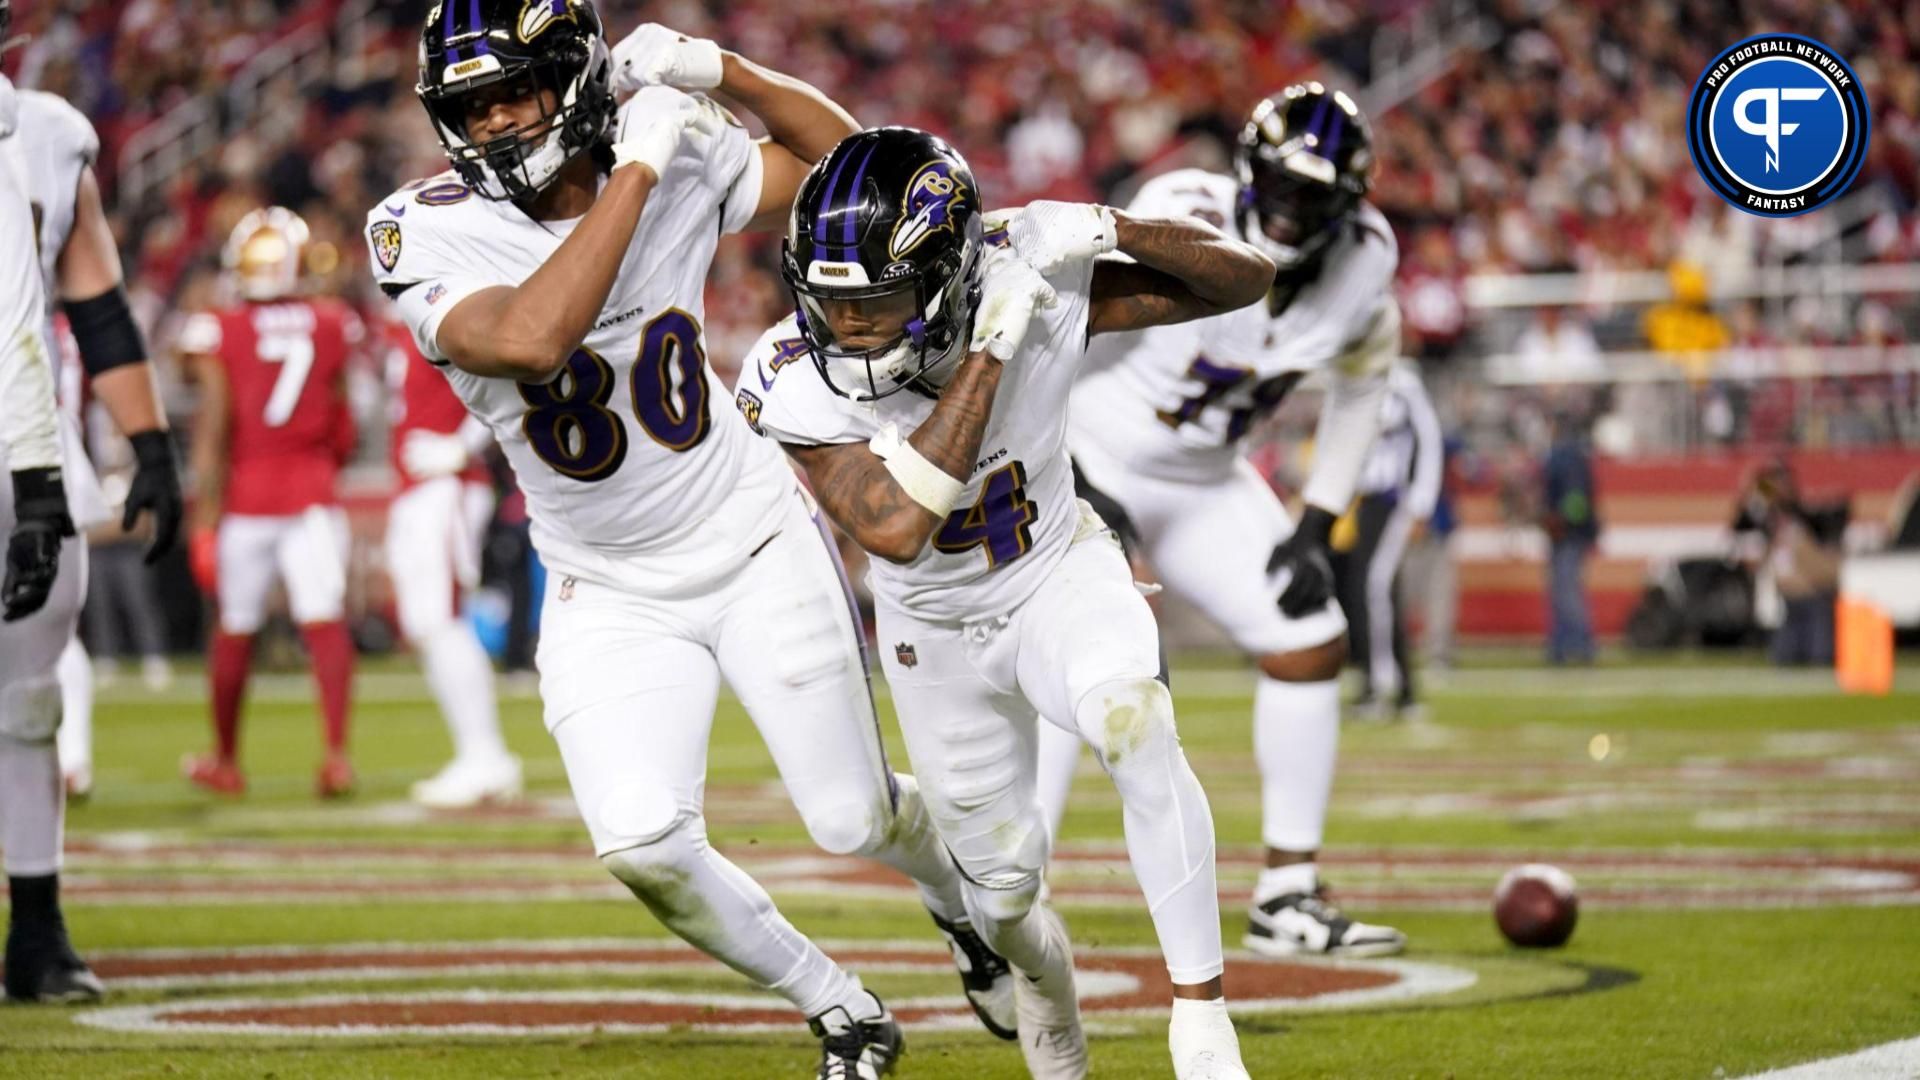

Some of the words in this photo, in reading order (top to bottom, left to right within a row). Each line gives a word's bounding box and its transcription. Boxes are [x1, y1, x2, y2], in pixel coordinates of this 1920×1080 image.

[819, 266, 850, 278] RAVENS
[592, 305, 644, 331] AVENS
[255, 334, 316, 427] 7
[769, 337, 811, 375] 4
[515, 306, 712, 483] 80
[931, 460, 1039, 571] 4
